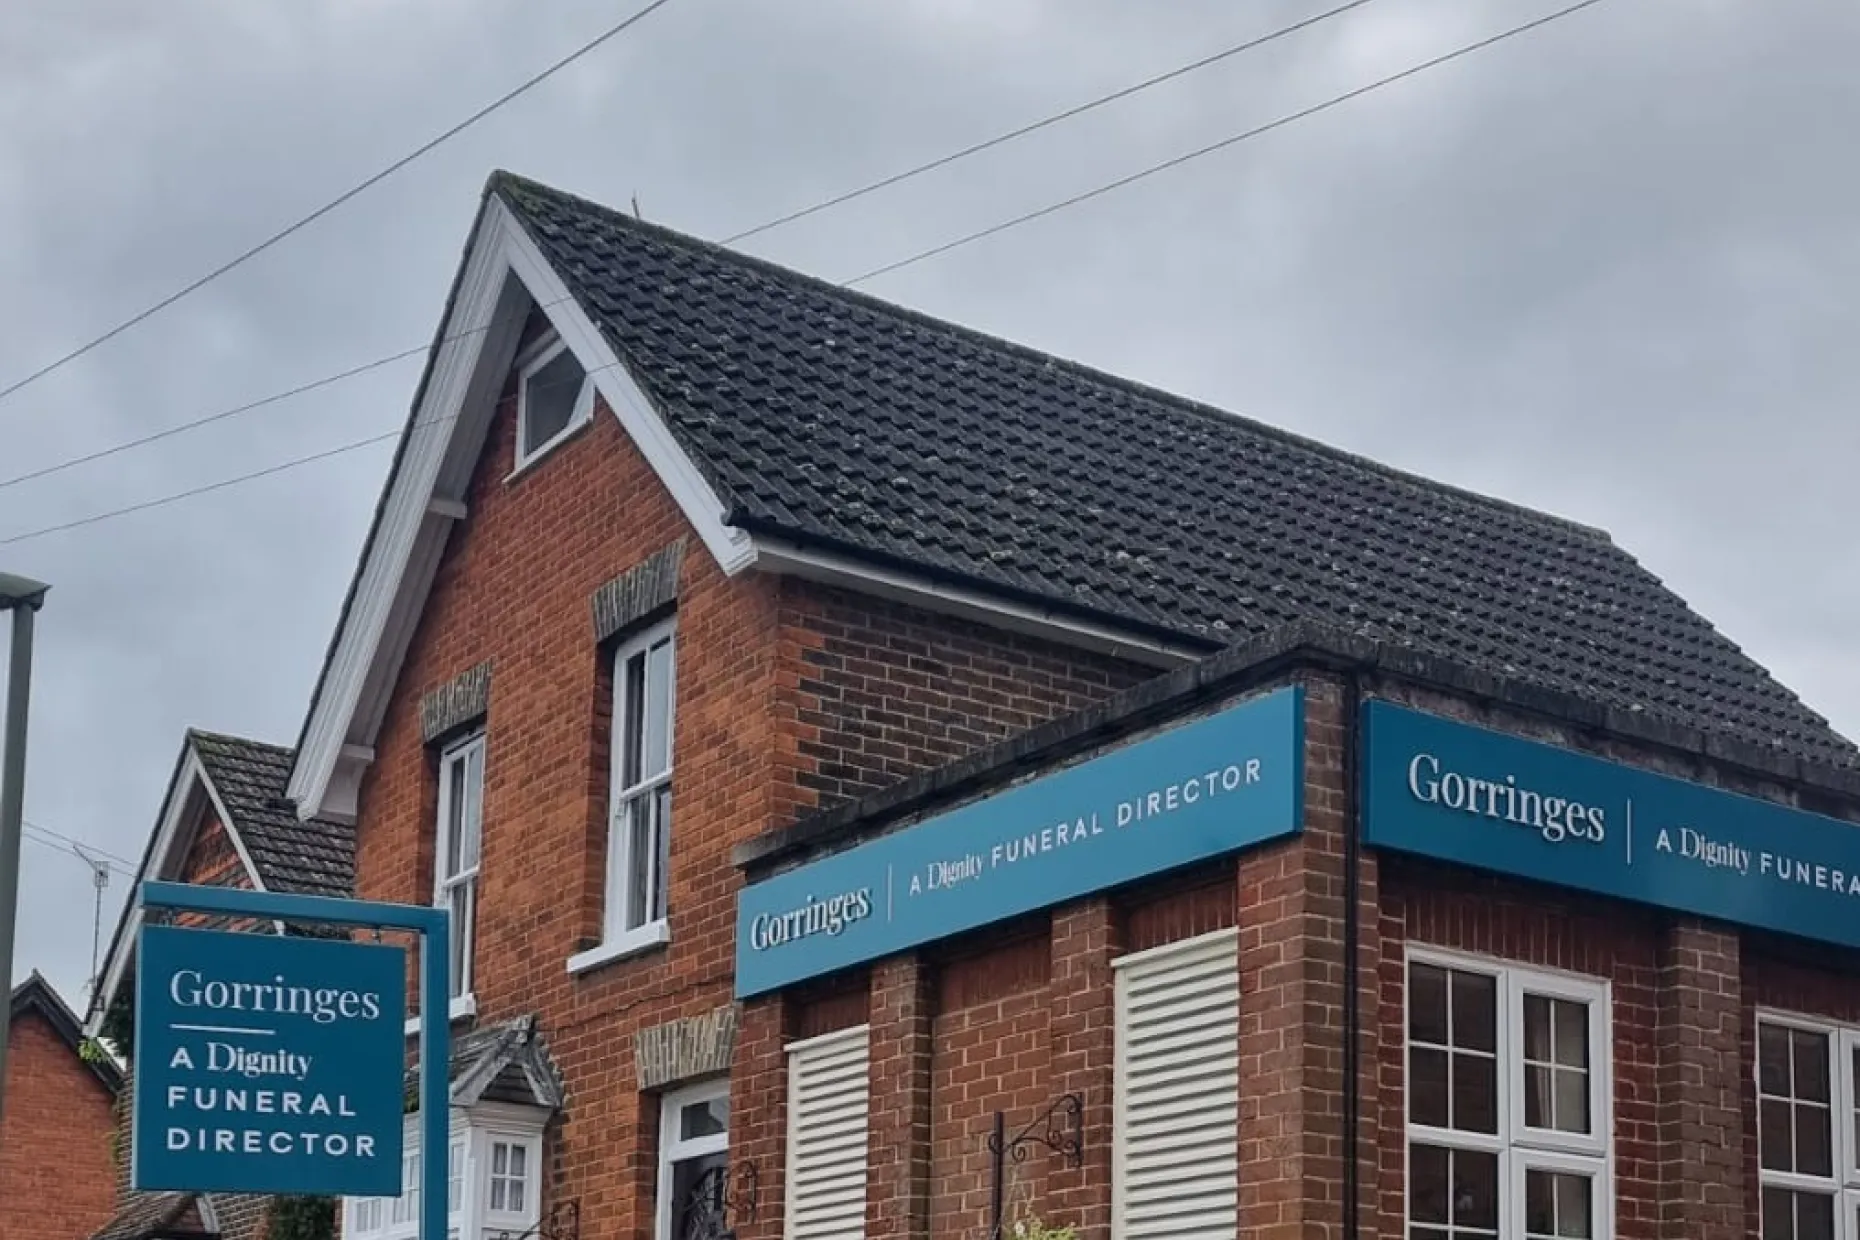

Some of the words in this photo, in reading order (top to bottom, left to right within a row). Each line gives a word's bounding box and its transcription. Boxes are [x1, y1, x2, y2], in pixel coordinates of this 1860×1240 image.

[1408, 753, 1606, 842] Gorringes
[1656, 829, 1673, 853] A
[1679, 827, 1751, 876] Dignity
[750, 884, 872, 951] Gorringes
[908, 874, 922, 897] A
[926, 851, 986, 890] Dignity
[991, 813, 1104, 869] FUNERAL
[1116, 757, 1262, 827] DIRECTOR
[169, 969, 380, 1023] Gorringes
[169, 1047, 195, 1069] A
[207, 1041, 313, 1080] Dignity
[167, 1085, 356, 1117] FUNERAL
[166, 1127, 376, 1157] DIRECTOR
